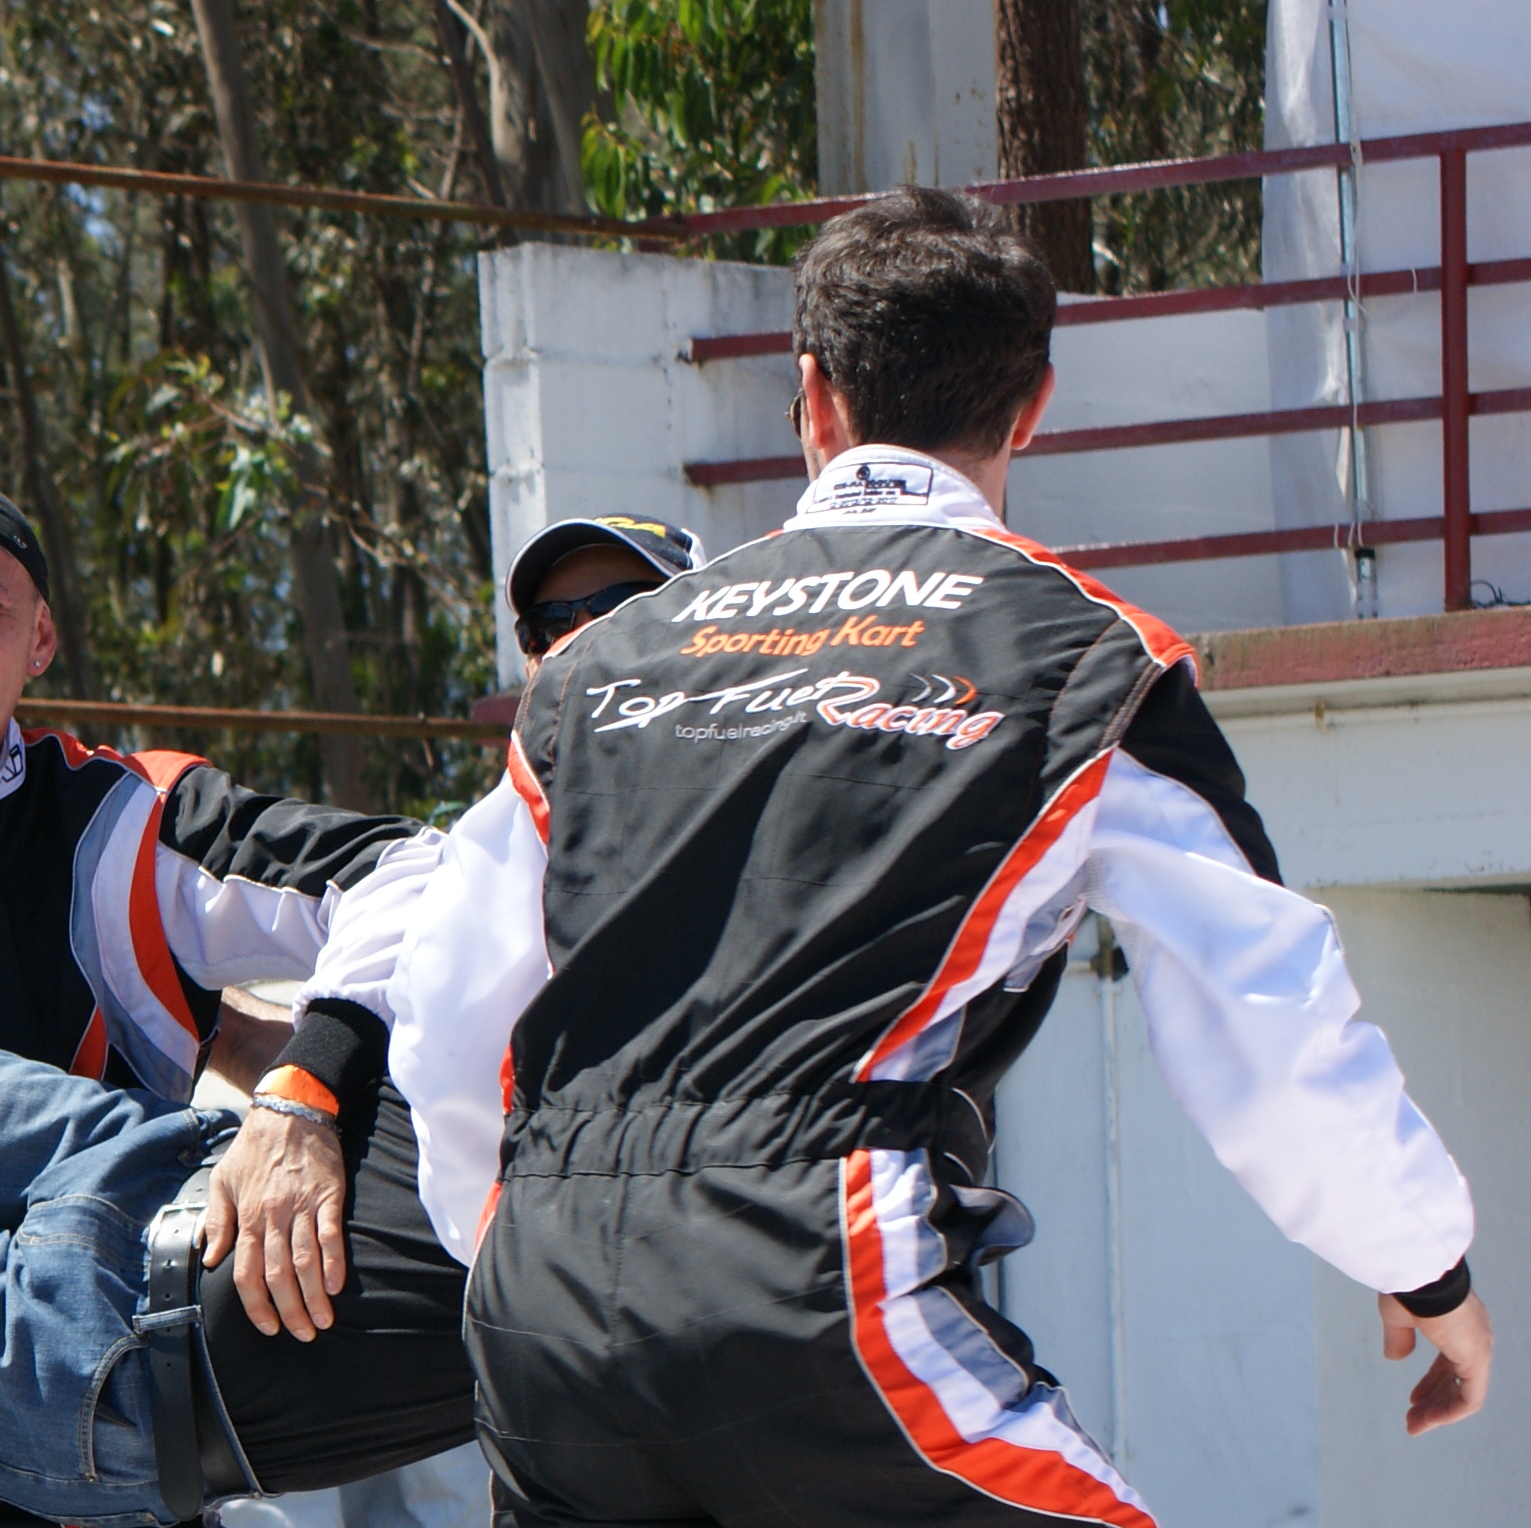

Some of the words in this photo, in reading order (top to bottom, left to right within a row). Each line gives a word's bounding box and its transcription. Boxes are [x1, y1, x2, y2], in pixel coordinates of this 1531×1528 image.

[671, 569, 985, 624] KEYSTONE
[680, 625, 833, 658] Sporting
[829, 615, 926, 648] Kart
